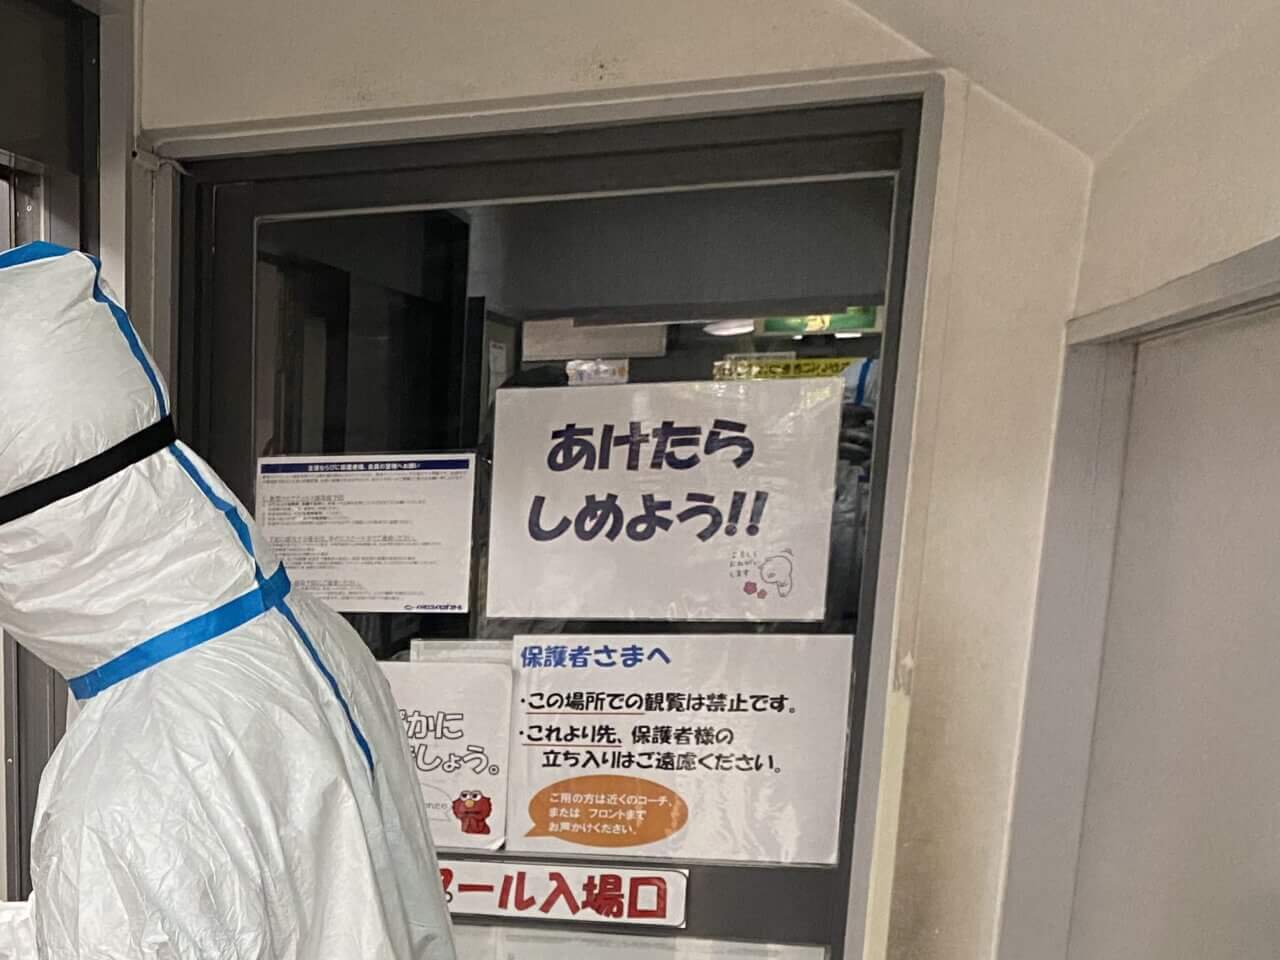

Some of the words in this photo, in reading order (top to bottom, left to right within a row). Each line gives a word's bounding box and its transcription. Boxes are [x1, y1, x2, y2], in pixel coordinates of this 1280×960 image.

[547, 419, 755, 473] あけたら
[520, 645, 671, 669] 保護者さまへ
[401, 709, 464, 740] かに
[410, 743, 500, 775] しょう。
[542, 749, 782, 774] 立ち入りはご遠慮ください。
